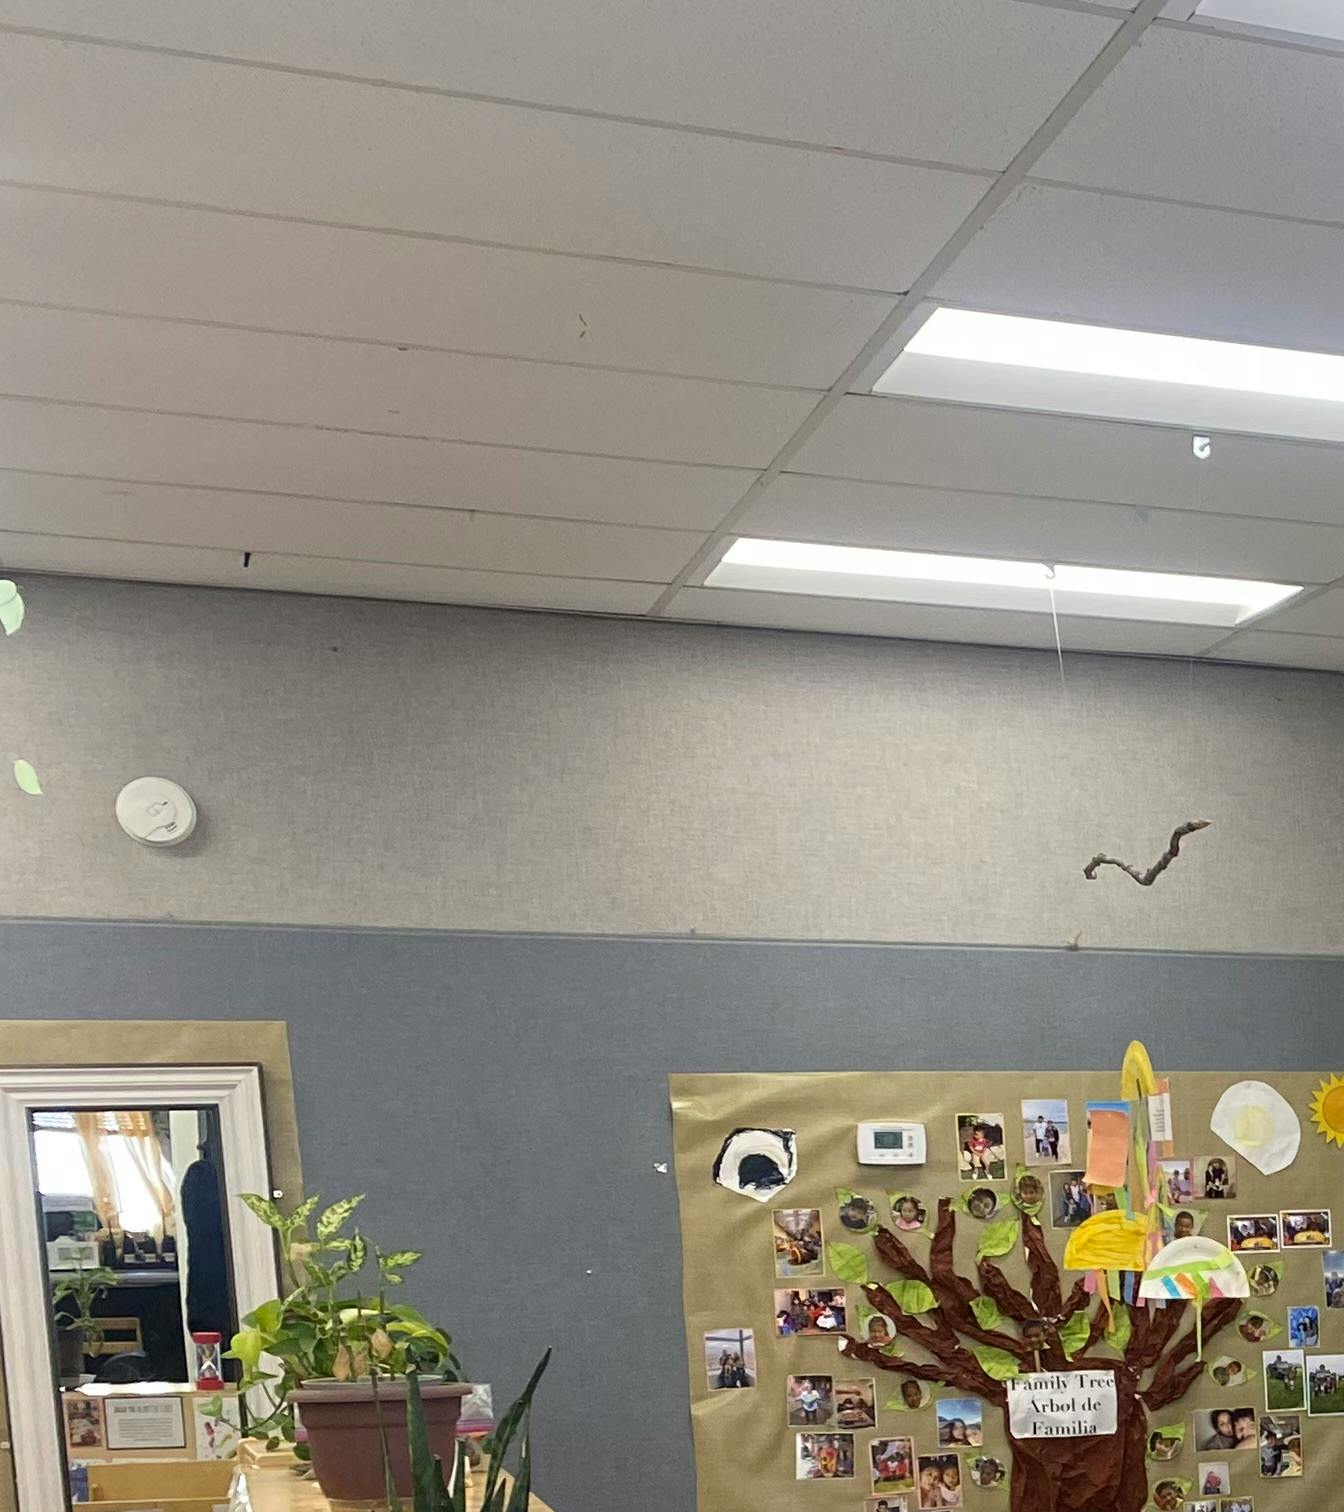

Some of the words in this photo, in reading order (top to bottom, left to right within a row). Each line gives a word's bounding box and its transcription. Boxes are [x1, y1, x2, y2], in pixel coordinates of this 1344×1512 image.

[1010, 1375, 1068, 1393] Family
[1075, 1374, 1114, 1388] Tree
[1082, 1397, 1102, 1411] de
[1033, 1420, 1097, 1435] Familia
